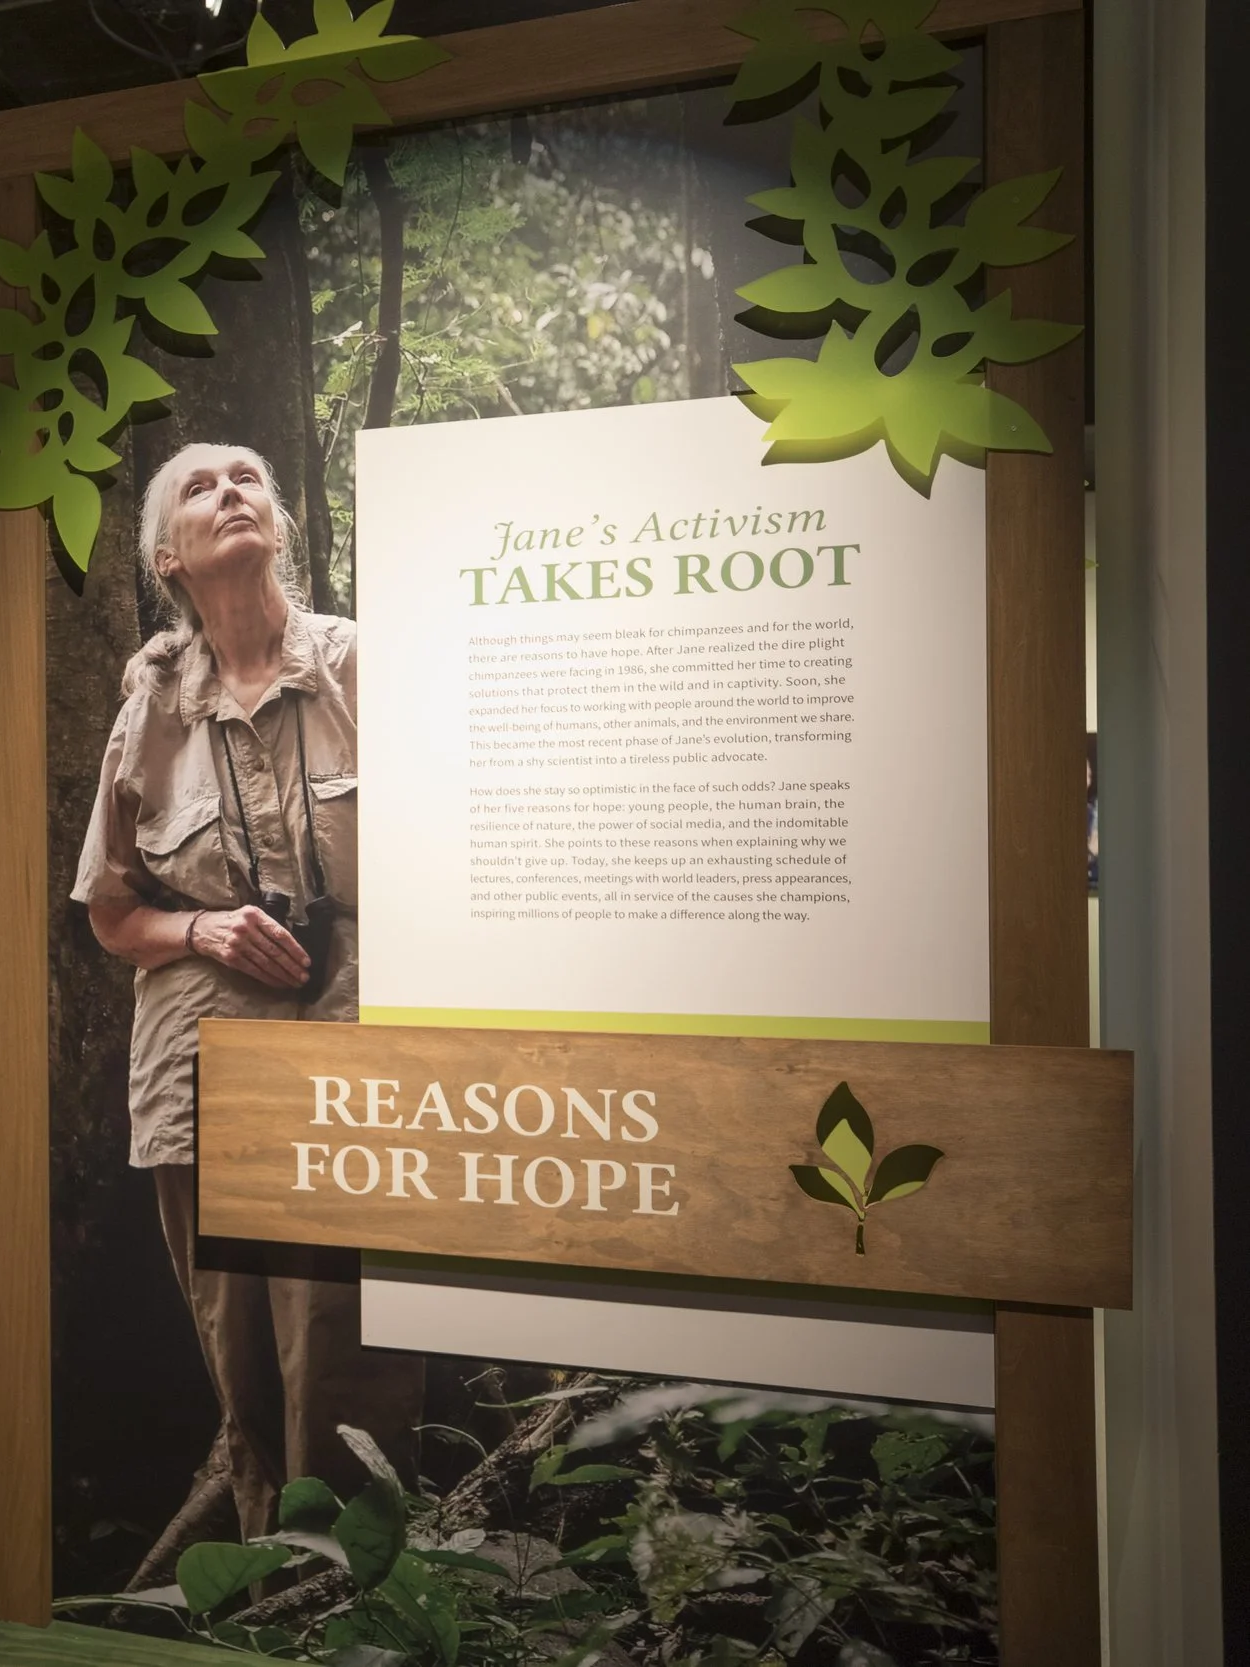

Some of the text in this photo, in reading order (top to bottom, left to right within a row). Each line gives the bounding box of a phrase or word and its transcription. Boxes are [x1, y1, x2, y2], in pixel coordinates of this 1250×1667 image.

[490, 505, 828, 561] Jane's Activism
[459, 543, 861, 606] TAKES ROOT
[582, 618, 853, 641] seem bleak for chimpanzees and for the world,
[580, 637, 844, 660] have hope. After Jane realized the dire plight
[617, 656, 852, 676] 1986, she committed her time to creating
[590, 674, 845, 693] them the wild and in captivity. Soon, she
[583, 693, 854, 715] working with people around the world to improve
[603, 711, 854, 730] other animals, and the environment we share.
[558, 730, 852, 749] most recent phase of Jane's evolution, transforming
[547, 750, 767, 766] scientist into a tireless public advocate.
[582, 779, 850, 797] optimistic the face of such odds? Jane speaks
[526, 798, 844, 814] reasons for hope: young people, the human brain, the
[536, 816, 848, 832] nature, the power of social media, and the indomitable
[470, 835, 846, 850] human spirit. She points these reasons when explaining why we
[470, 854, 846, 868] shouldn't give up. Today, she keeps up an exhausting schedule of
[470, 872, 851, 886] lectures, conferences, meetings with world leaders, press appearances,
[470, 891, 850, 904] and other public events, all in service of the causes she champions,
[470, 909, 516, 922] inspiring
[517, 909, 559, 919] millions
[561, 909, 572, 919] of
[574, 909, 612, 922] people
[613, 909, 625, 919] to
[627, 909, 658, 919] make
[669, 909, 725, 920] difference
[727, 909, 760, 922] along
[762, 909, 781, 920] the
[783, 912, 809, 922] way.
[308, 1075, 660, 1144] REASONS
[290, 1142, 680, 1217] FOR HOPE
